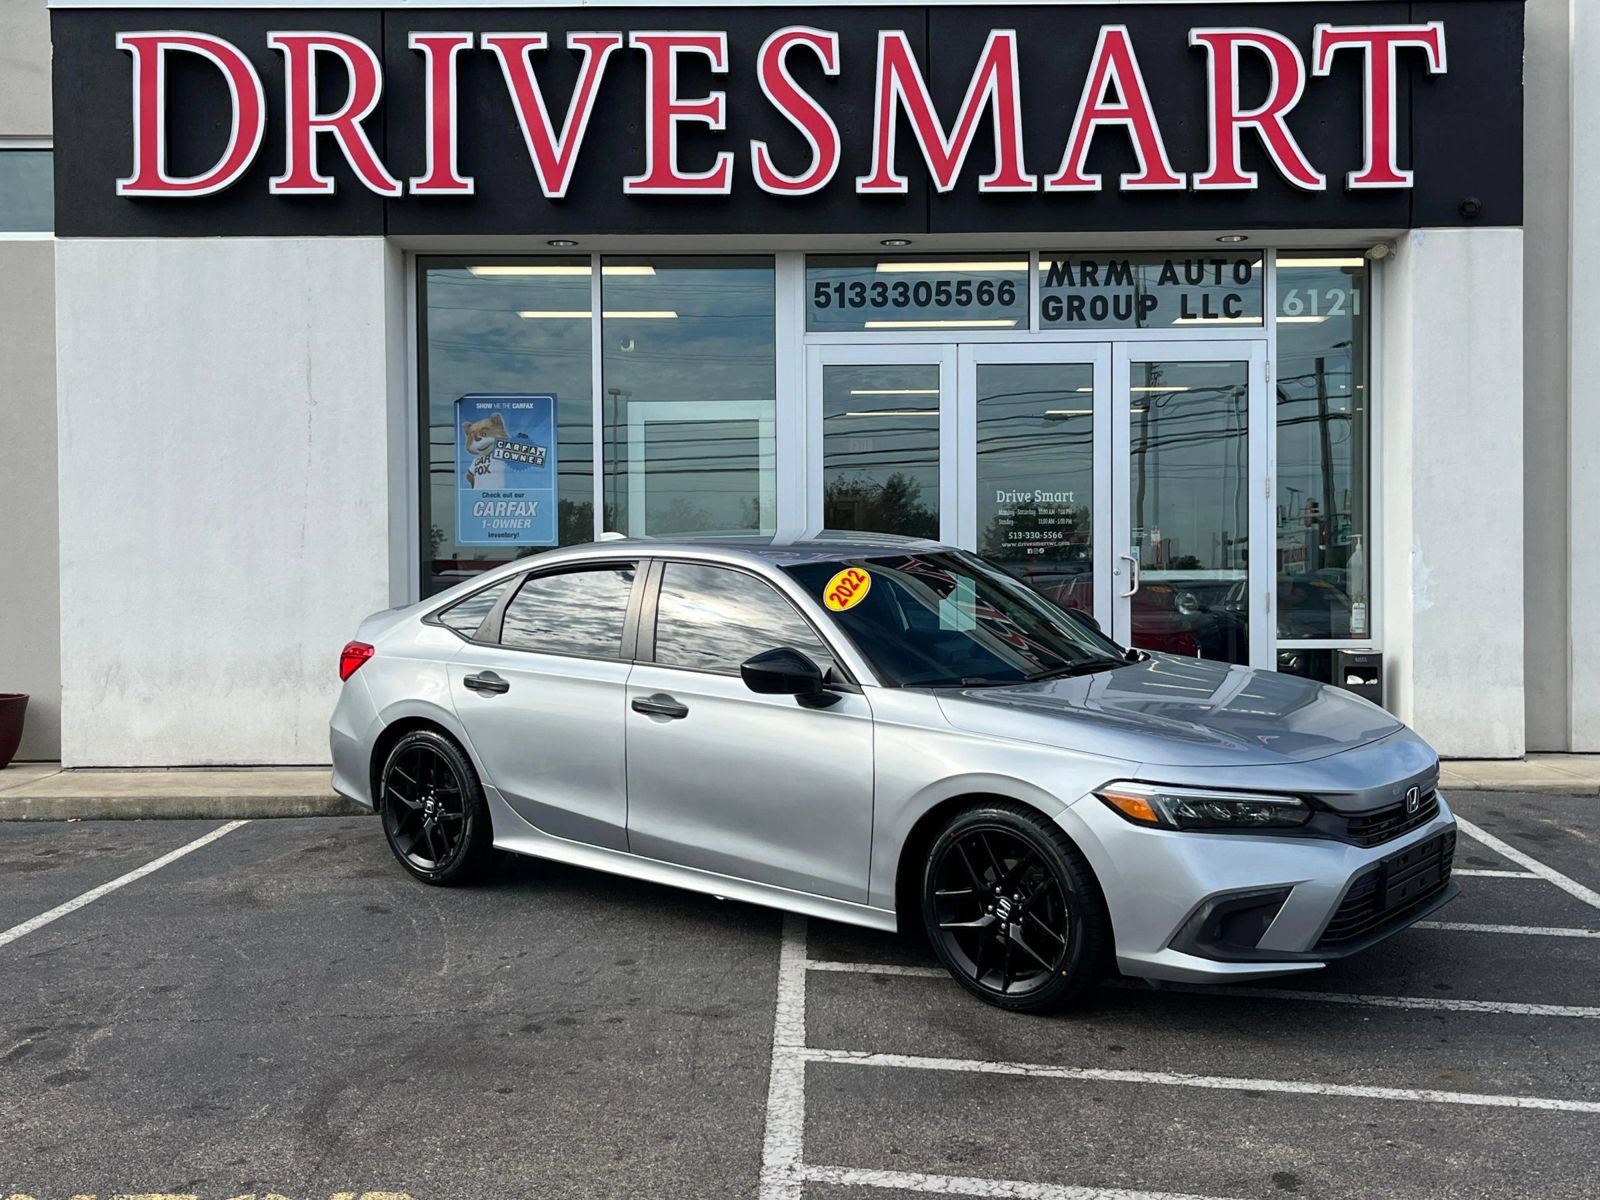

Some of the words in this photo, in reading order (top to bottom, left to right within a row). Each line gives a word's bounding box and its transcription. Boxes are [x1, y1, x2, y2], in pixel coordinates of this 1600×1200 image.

[115, 20, 1449, 199] DRIVESMART
[1044, 260, 1135, 287] MRM
[1157, 258, 1253, 286] AUTO
[813, 280, 1016, 309] 5133305566
[1282, 288, 1361, 316] 6121
[1041, 293, 1159, 322] GROUP
[1180, 293, 1243, 320] LLC
[497, 441, 545, 457] CARFAX
[474, 464, 492, 475] FOX
[482, 491, 501, 499] Check
[996, 489, 1032, 503] Drive
[1034, 489, 1074, 503] Smart
[473, 501, 539, 517] CARFAX
[1008, 531, 1063, 539] 513-330-5566
[829, 570, 865, 607] 2022
